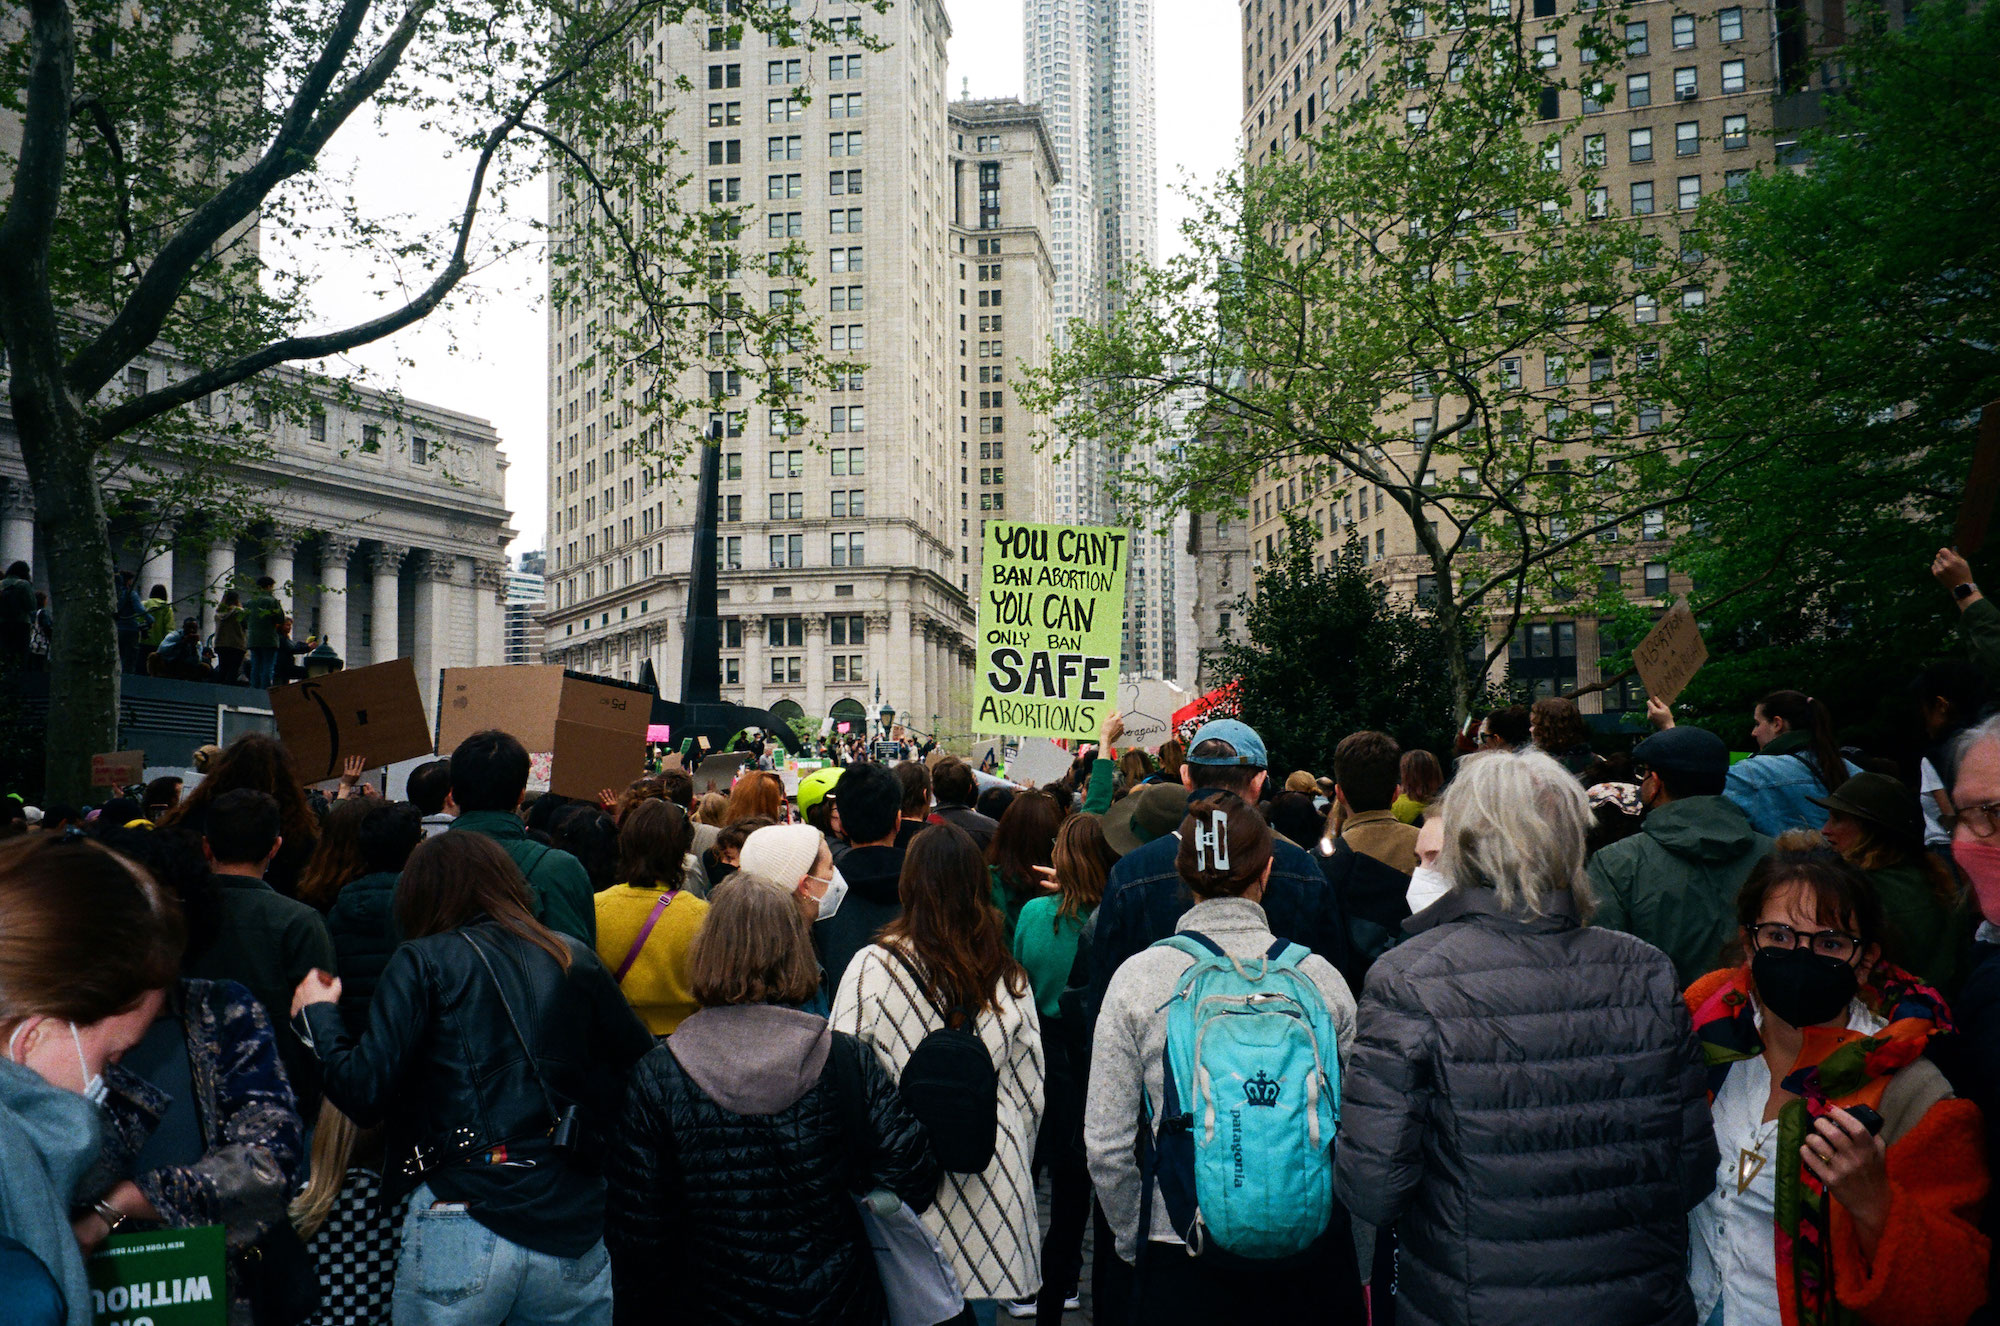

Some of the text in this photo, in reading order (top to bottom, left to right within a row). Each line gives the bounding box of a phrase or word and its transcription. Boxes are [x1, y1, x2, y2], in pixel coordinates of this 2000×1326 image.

[995, 526, 1126, 571] YOU CAN'T
[992, 564, 1114, 592] BAN ABORTION
[990, 590, 1096, 633] YOU CAN
[986, 630, 1082, 651] ONLY BAN
[988, 648, 1110, 700] SAFE
[979, 695, 1095, 733] ABORTIONS
[1230, 1109, 1246, 1188] patagonia
[127, 1245, 145, 1254] CITY
[145, 1242, 167, 1252] YORK
[167, 1241, 185, 1250] NEW
[90, 1275, 213, 1314] WITHOU
